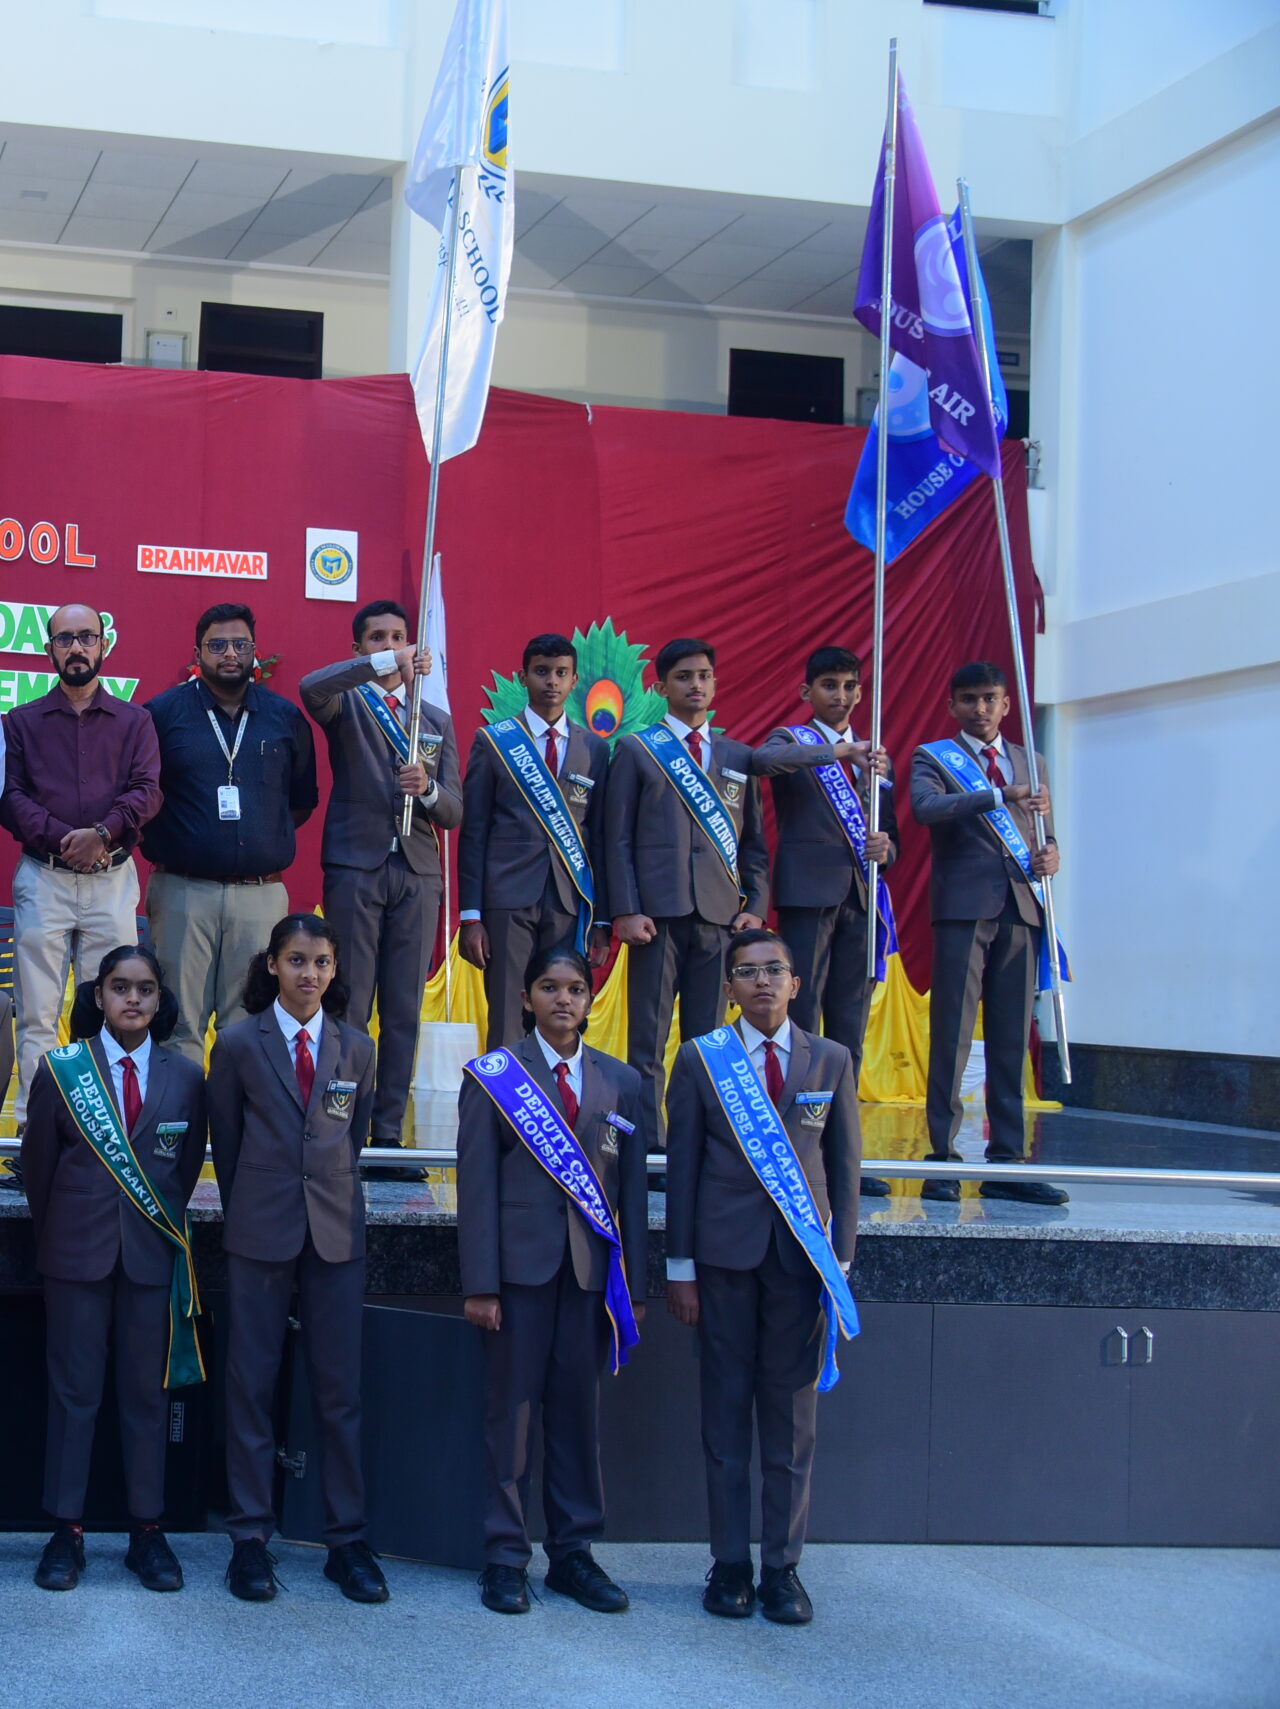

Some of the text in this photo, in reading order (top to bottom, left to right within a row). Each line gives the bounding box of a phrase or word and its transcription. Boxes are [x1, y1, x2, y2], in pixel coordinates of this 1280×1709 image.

[458, 211, 500, 324] SCHOOL
[928, 383, 976, 426] AIR
[894, 462, 953, 519] HOUSE
[140, 547, 265, 577] BRAHMAVAR
[508, 743, 586, 872] DISCIPLINE MINISTER
[670, 757, 716, 813] SPORTS
[70, 1087, 107, 1142] HOUSE
[514, 1082, 575, 1157] DEPUTY
[718, 1077, 755, 1135] HOUSE
[747, 1137, 768, 1160] OF
[731, 1058, 780, 1136] DEPUTY
[771, 1141, 817, 1228] CAPTAIN
[513, 1106, 581, 1194] HOUSE OF
[172, 1402, 182, 1442] AHUJA
